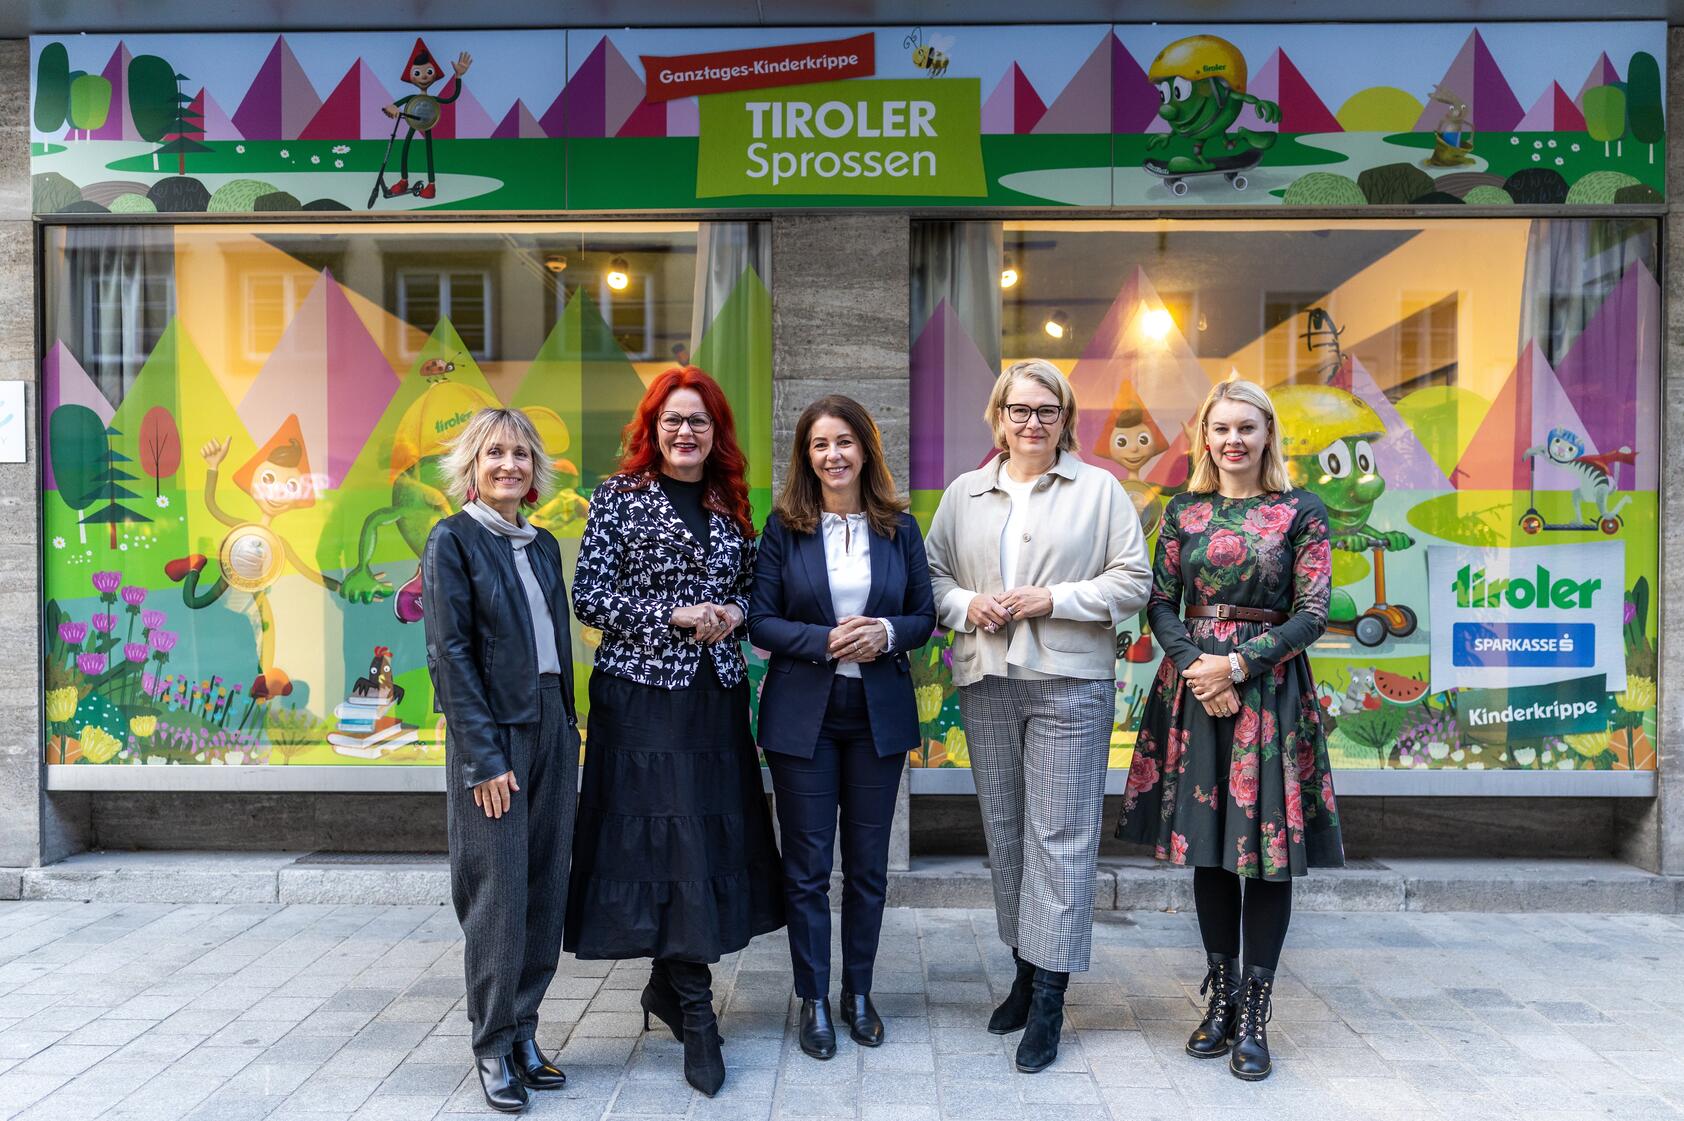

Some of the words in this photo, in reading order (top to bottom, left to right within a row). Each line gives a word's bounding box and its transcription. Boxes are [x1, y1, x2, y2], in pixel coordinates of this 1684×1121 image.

[660, 54, 858, 83] Ganztages-Kinderkrippe
[746, 101, 937, 138] TIROLER
[746, 142, 936, 185] Sprossen
[435, 411, 472, 433] tiroler
[1452, 564, 1601, 609] tiroler
[1474, 638, 1557, 652] SPARKASSE
[1469, 701, 1597, 726] Kinderkrippe
